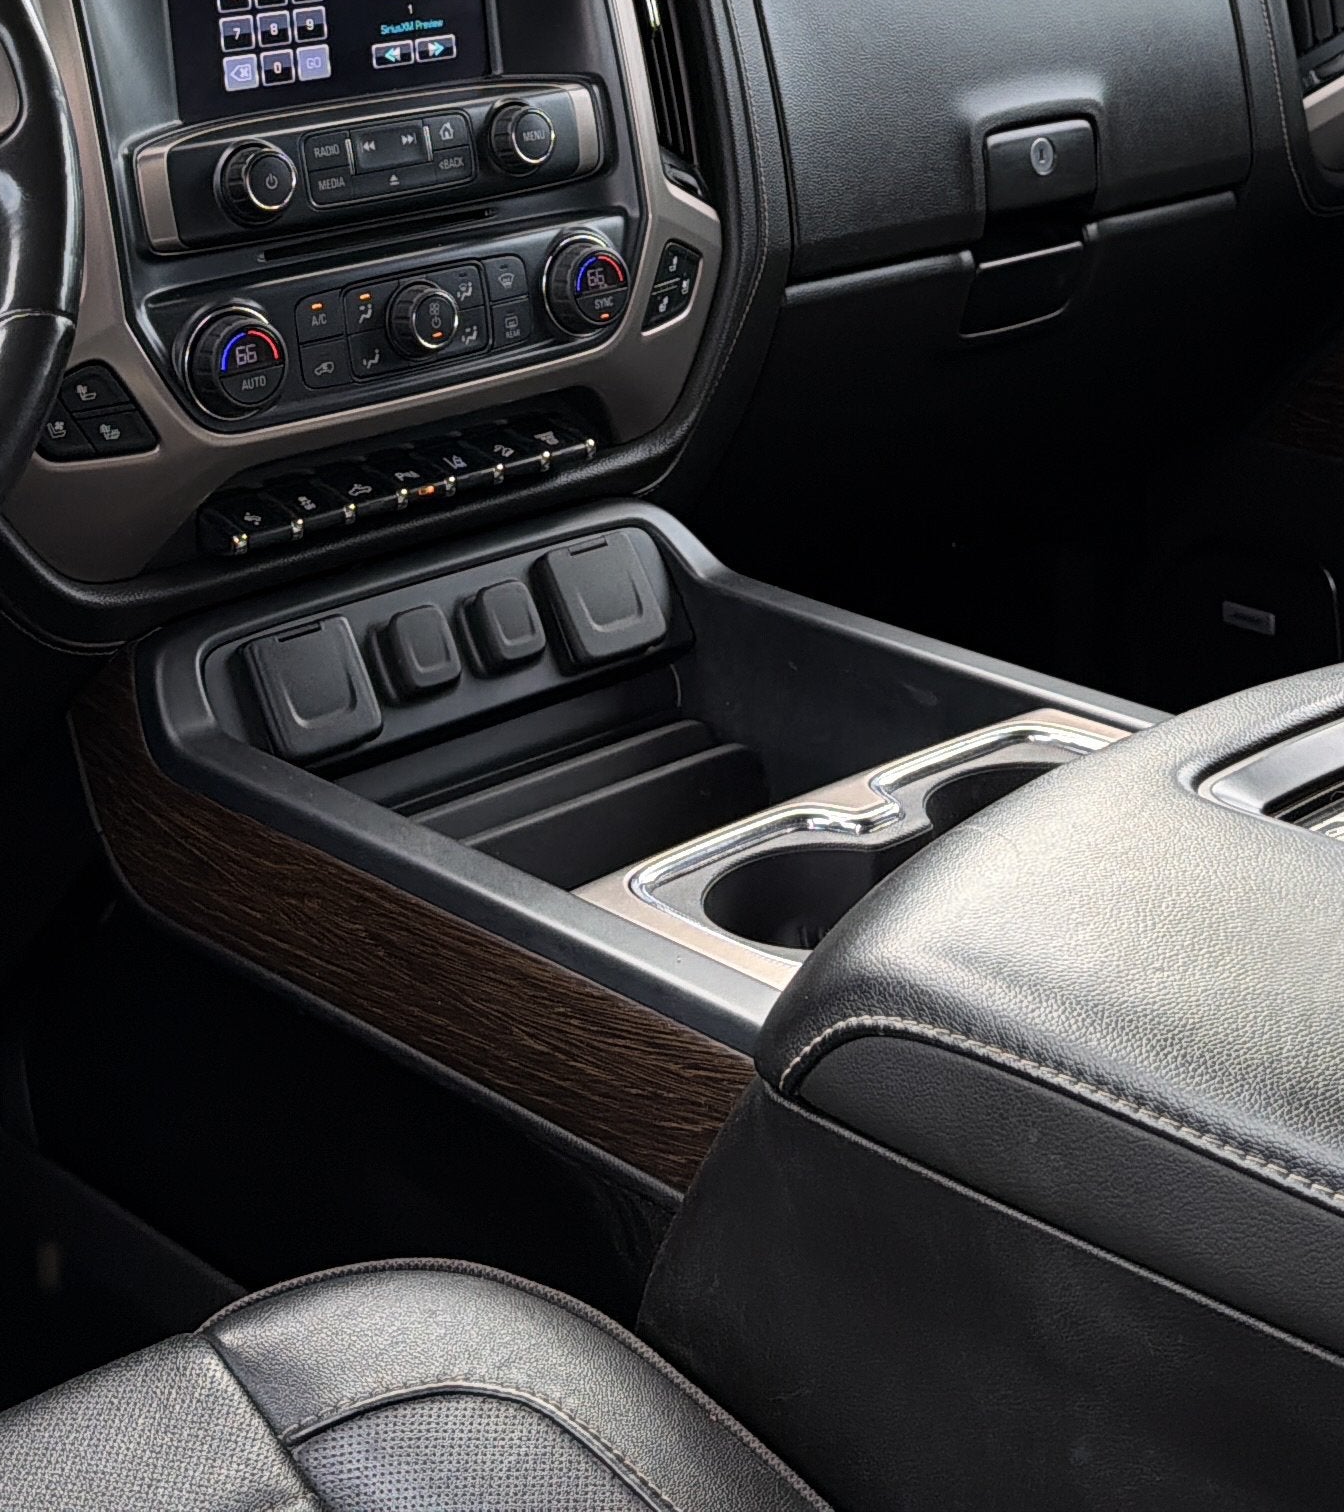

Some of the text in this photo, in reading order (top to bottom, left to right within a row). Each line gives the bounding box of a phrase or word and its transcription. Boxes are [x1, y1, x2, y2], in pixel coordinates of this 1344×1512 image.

[407, 3, 413, 15] 1
[269, 23, 278, 36] 8
[306, 18, 314, 31] 9
[380, 19, 444, 35] SiriusXM Preview
[232, 27, 241, 41] 7
[273, 61, 282, 74] 0
[306, 56, 321, 69] GO
[522, 129, 546, 142] MENU
[313, 143, 340, 158] RADIO
[317, 175, 345, 191] MEDIA
[587, 267, 605, 287] 66
[594, 298, 614, 311] SYNC
[311, 313, 328, 327] A/C
[236, 343, 258, 366] 66
[241, 375, 267, 391] AUTO
